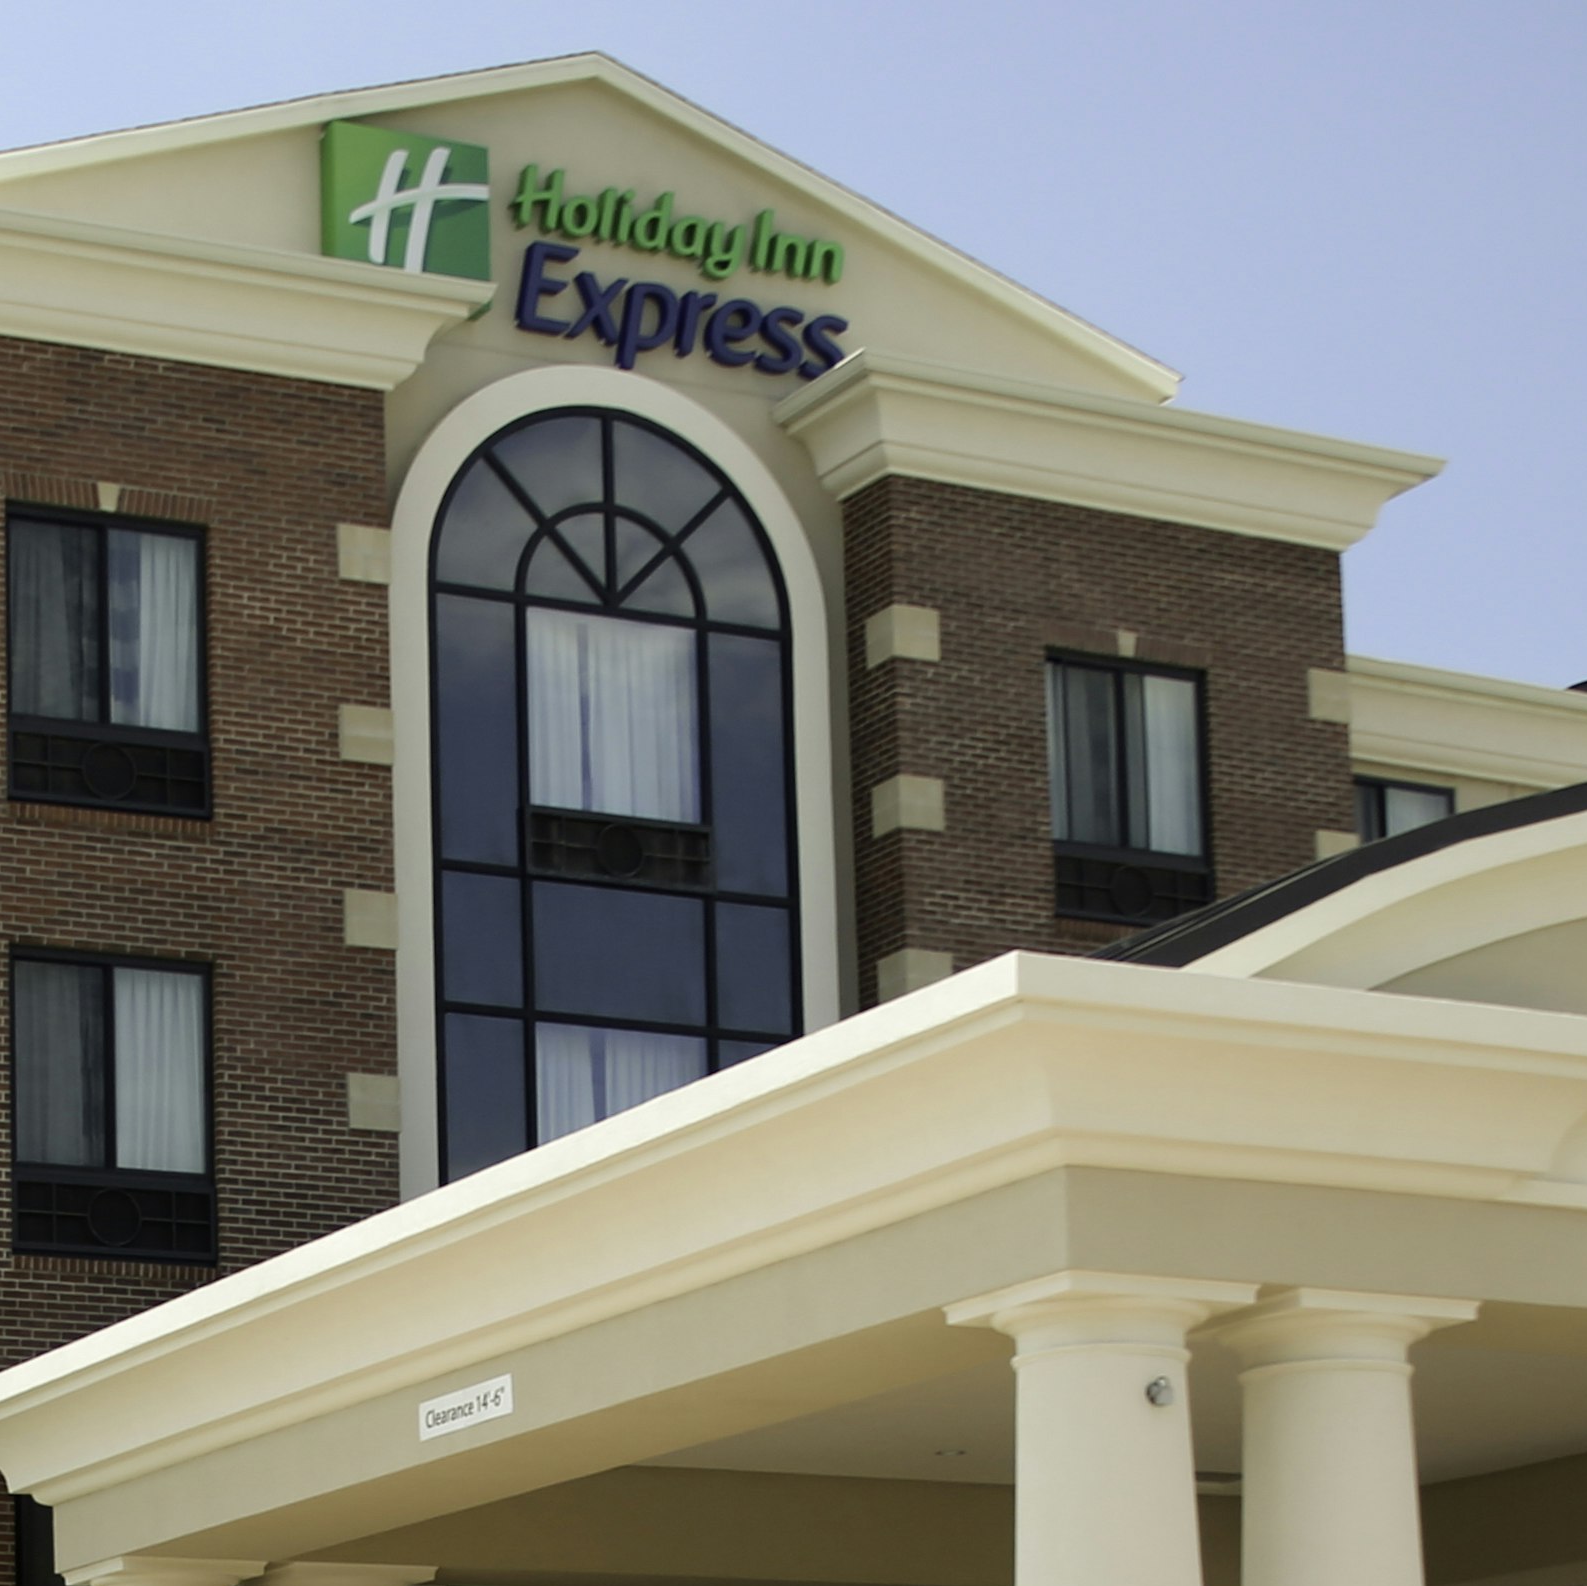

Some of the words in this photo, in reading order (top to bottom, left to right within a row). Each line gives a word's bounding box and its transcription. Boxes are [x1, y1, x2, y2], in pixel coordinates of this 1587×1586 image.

[510, 163, 747, 281] Holiday
[750, 208, 845, 284] Inn
[515, 240, 849, 380] Express
[425, 1401, 474, 1429] Clearance
